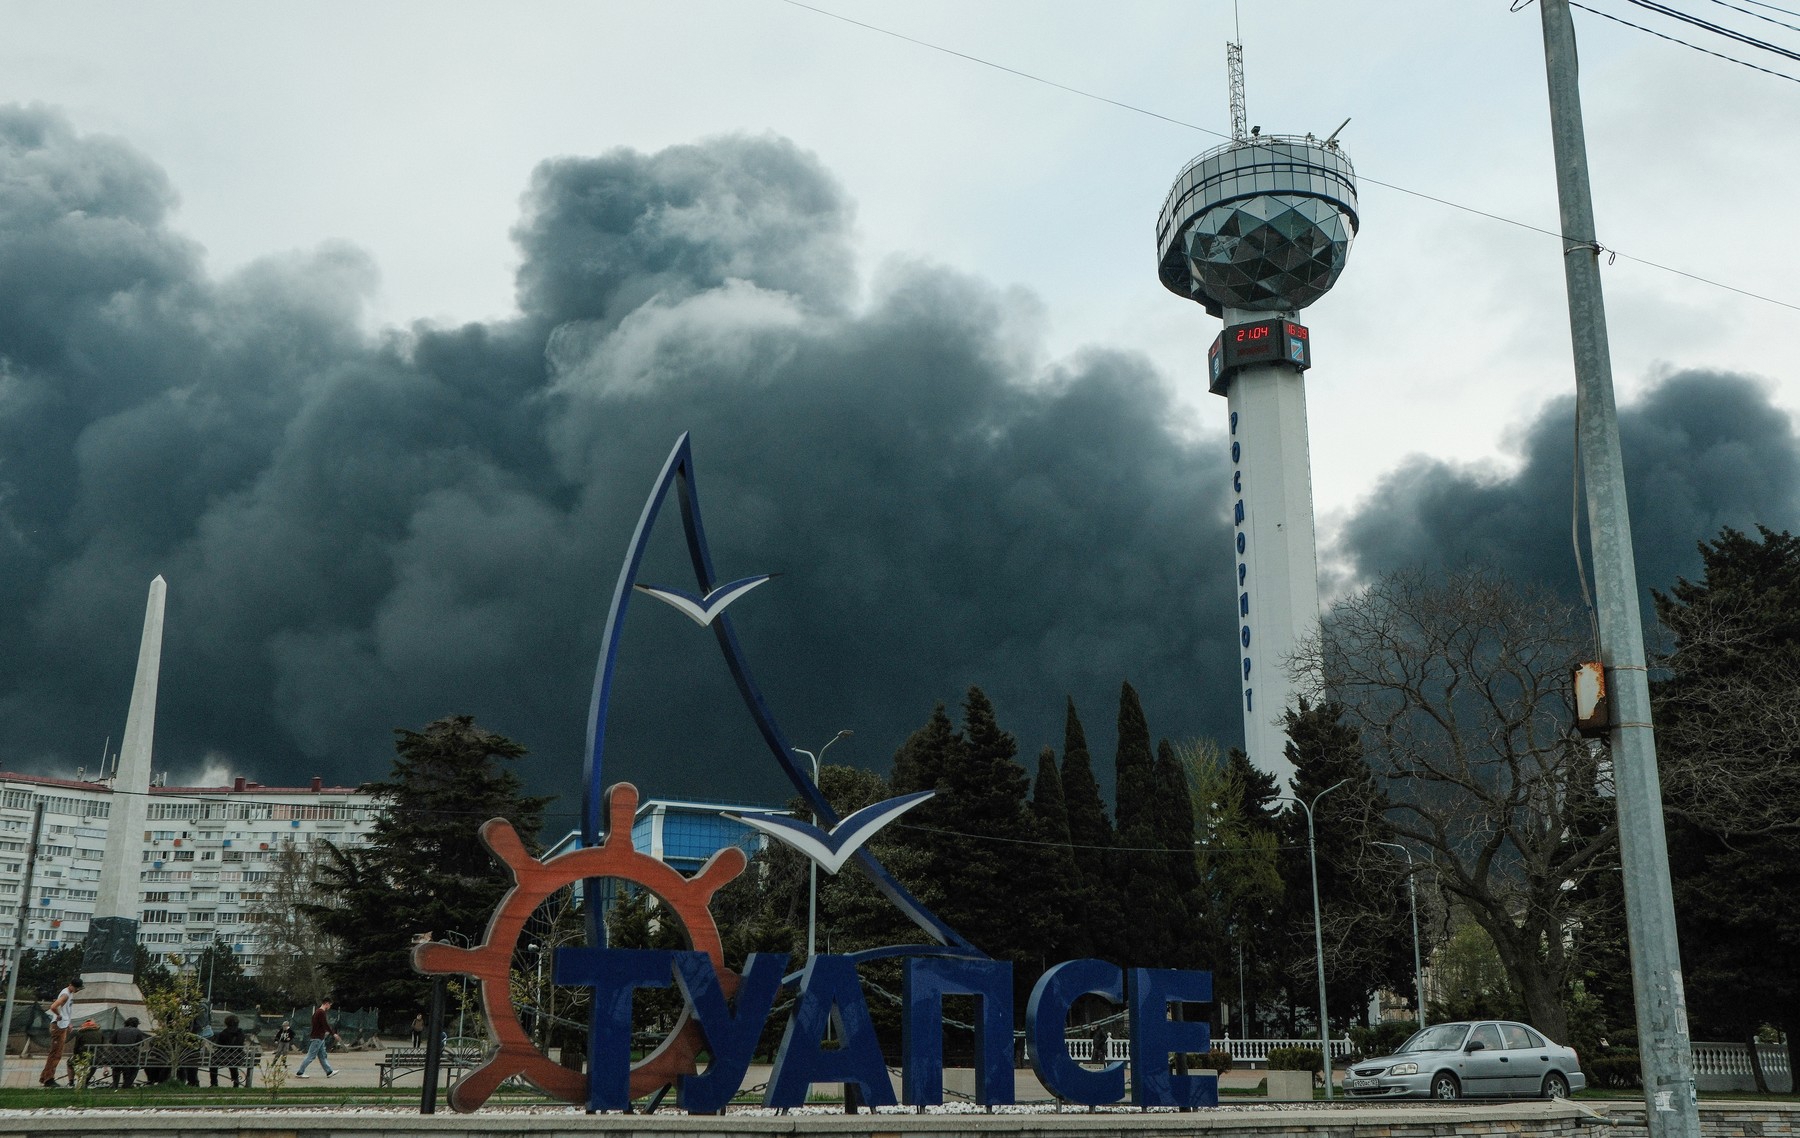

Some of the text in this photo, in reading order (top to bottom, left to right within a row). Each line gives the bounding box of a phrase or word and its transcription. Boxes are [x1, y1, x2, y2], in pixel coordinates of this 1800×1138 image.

[1237, 327, 1268, 341] 21.04
[1230, 411, 1252, 712] РОСМОРПОРТ
[552, 947, 1219, 1115] ТУАПСЕ
